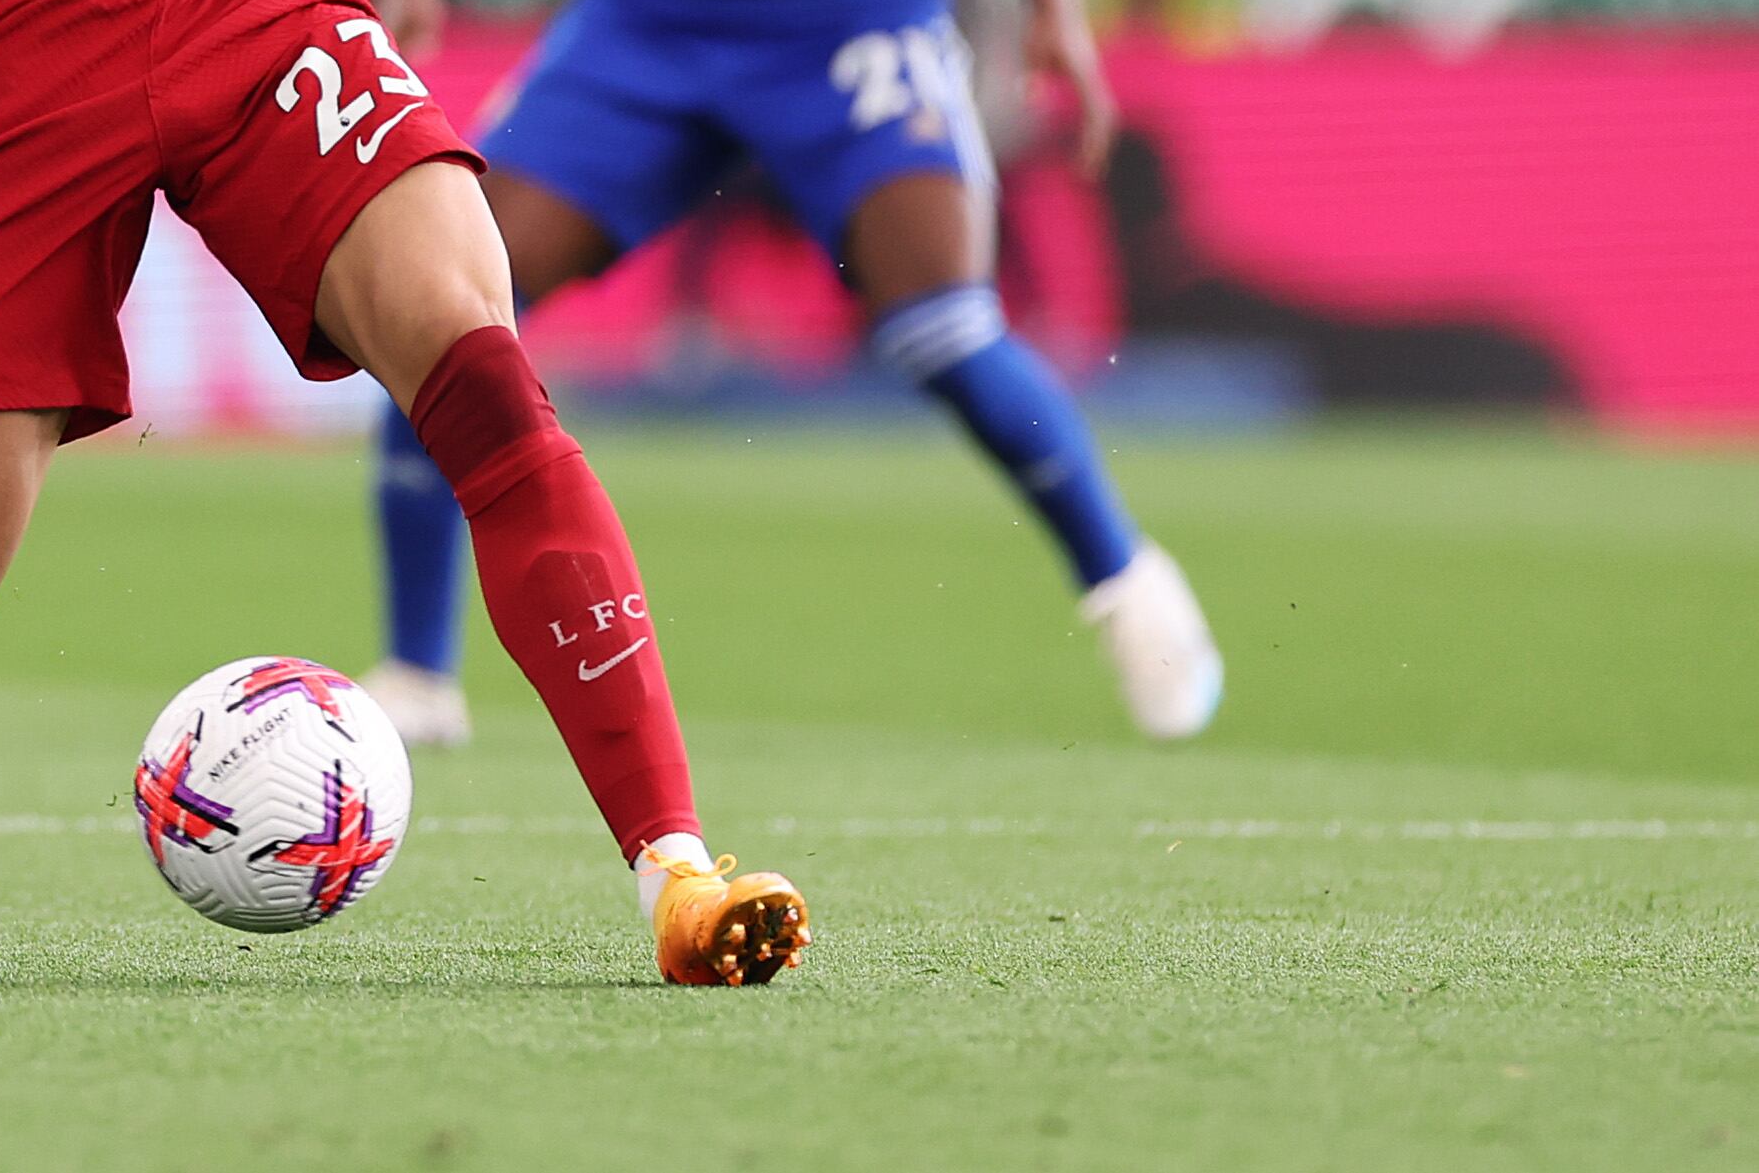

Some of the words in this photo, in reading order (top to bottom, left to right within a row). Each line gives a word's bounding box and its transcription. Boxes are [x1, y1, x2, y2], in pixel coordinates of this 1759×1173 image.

[275, 18, 430, 156] 23
[208, 748, 241, 783] NIKE
[241, 707, 291, 750] FLIGHT
